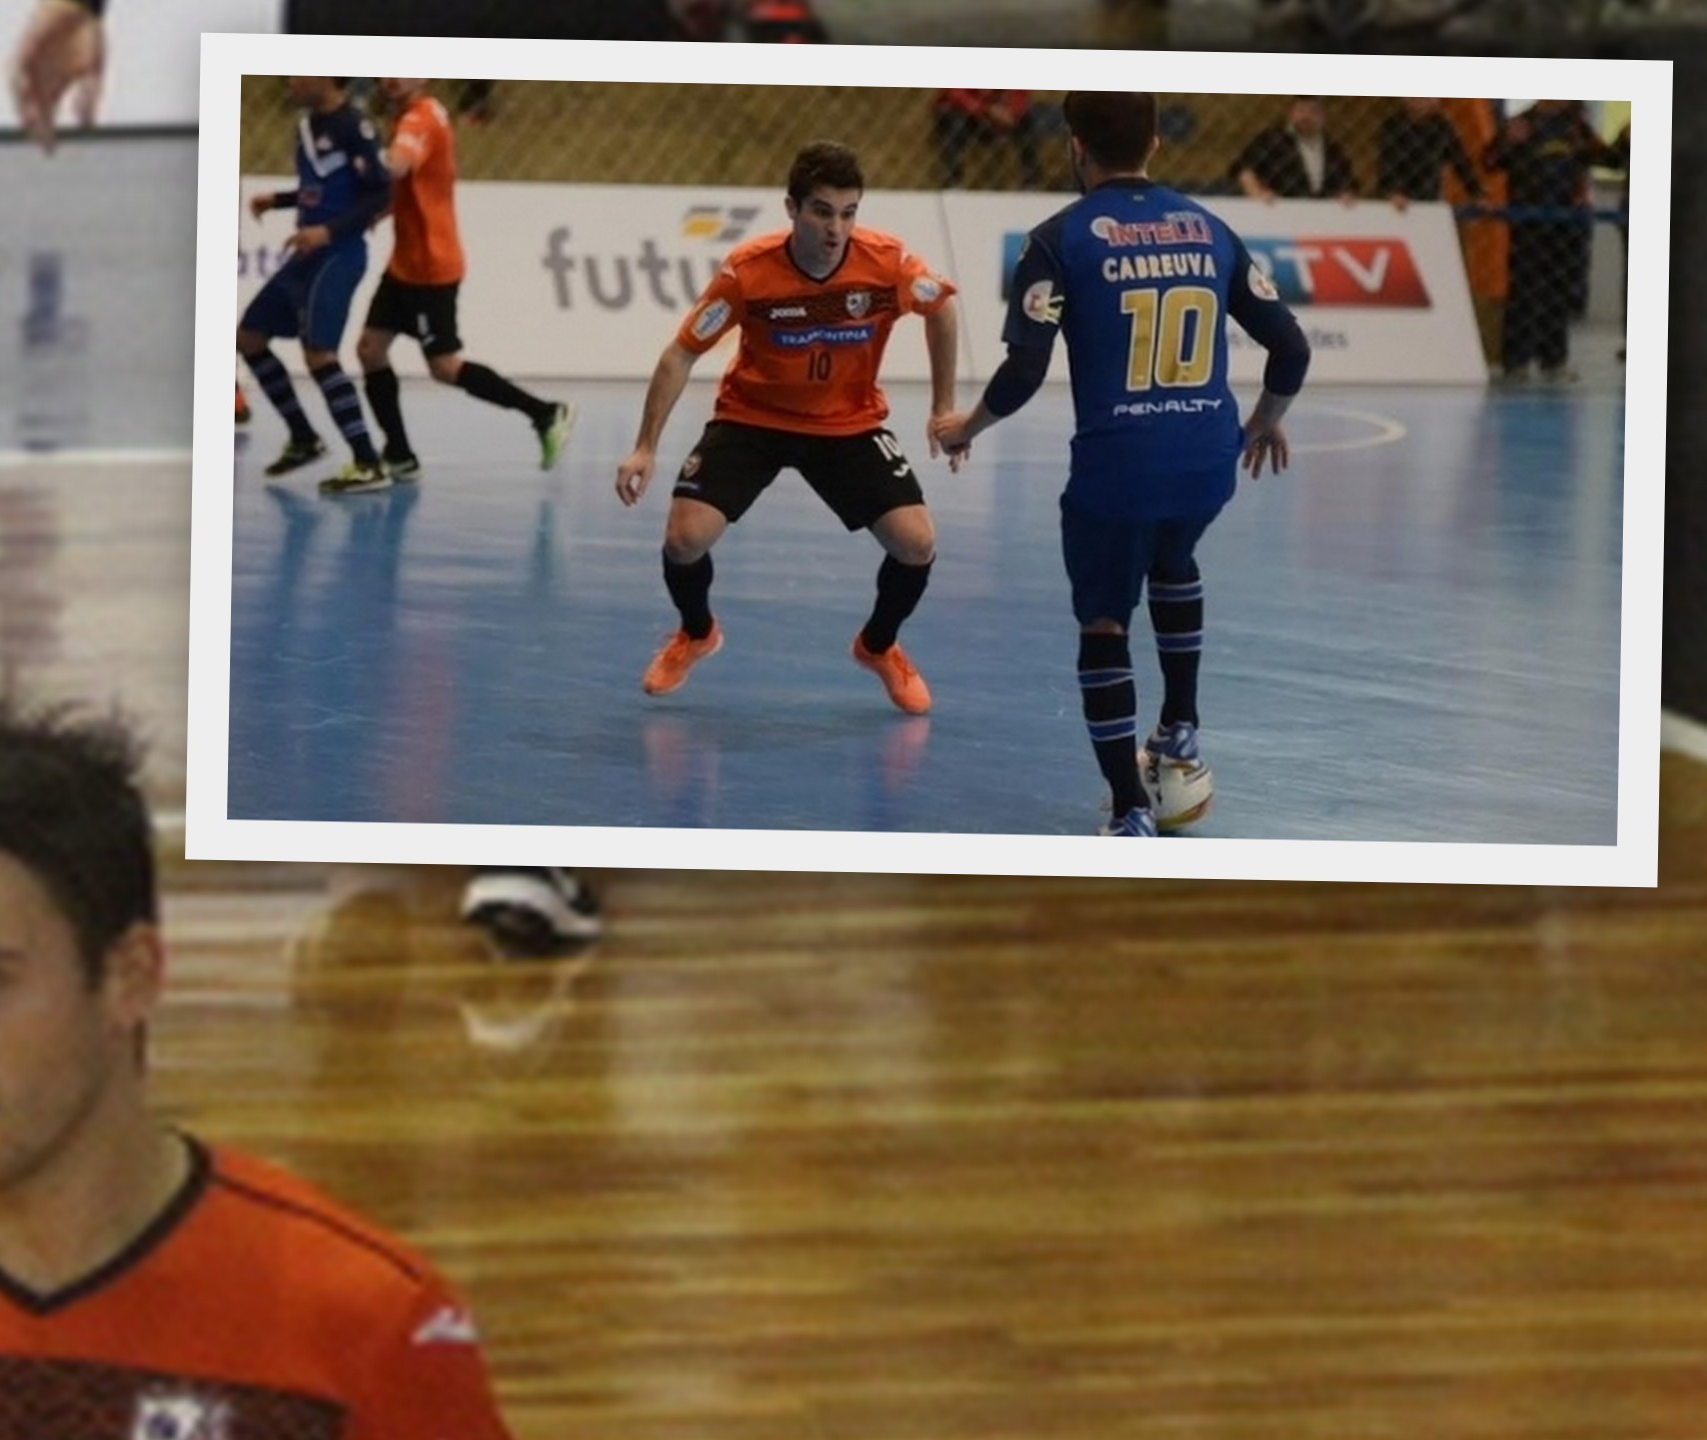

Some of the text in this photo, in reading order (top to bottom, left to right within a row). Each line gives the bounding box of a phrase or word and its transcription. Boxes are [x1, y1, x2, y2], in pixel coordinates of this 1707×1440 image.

[780, 328, 870, 345] TRAMONTINA
[1120, 286, 1218, 392] 10
[808, 349, 832, 381] 10
[1113, 399, 1222, 416] PENALTY
[873, 434, 902, 460] 10
